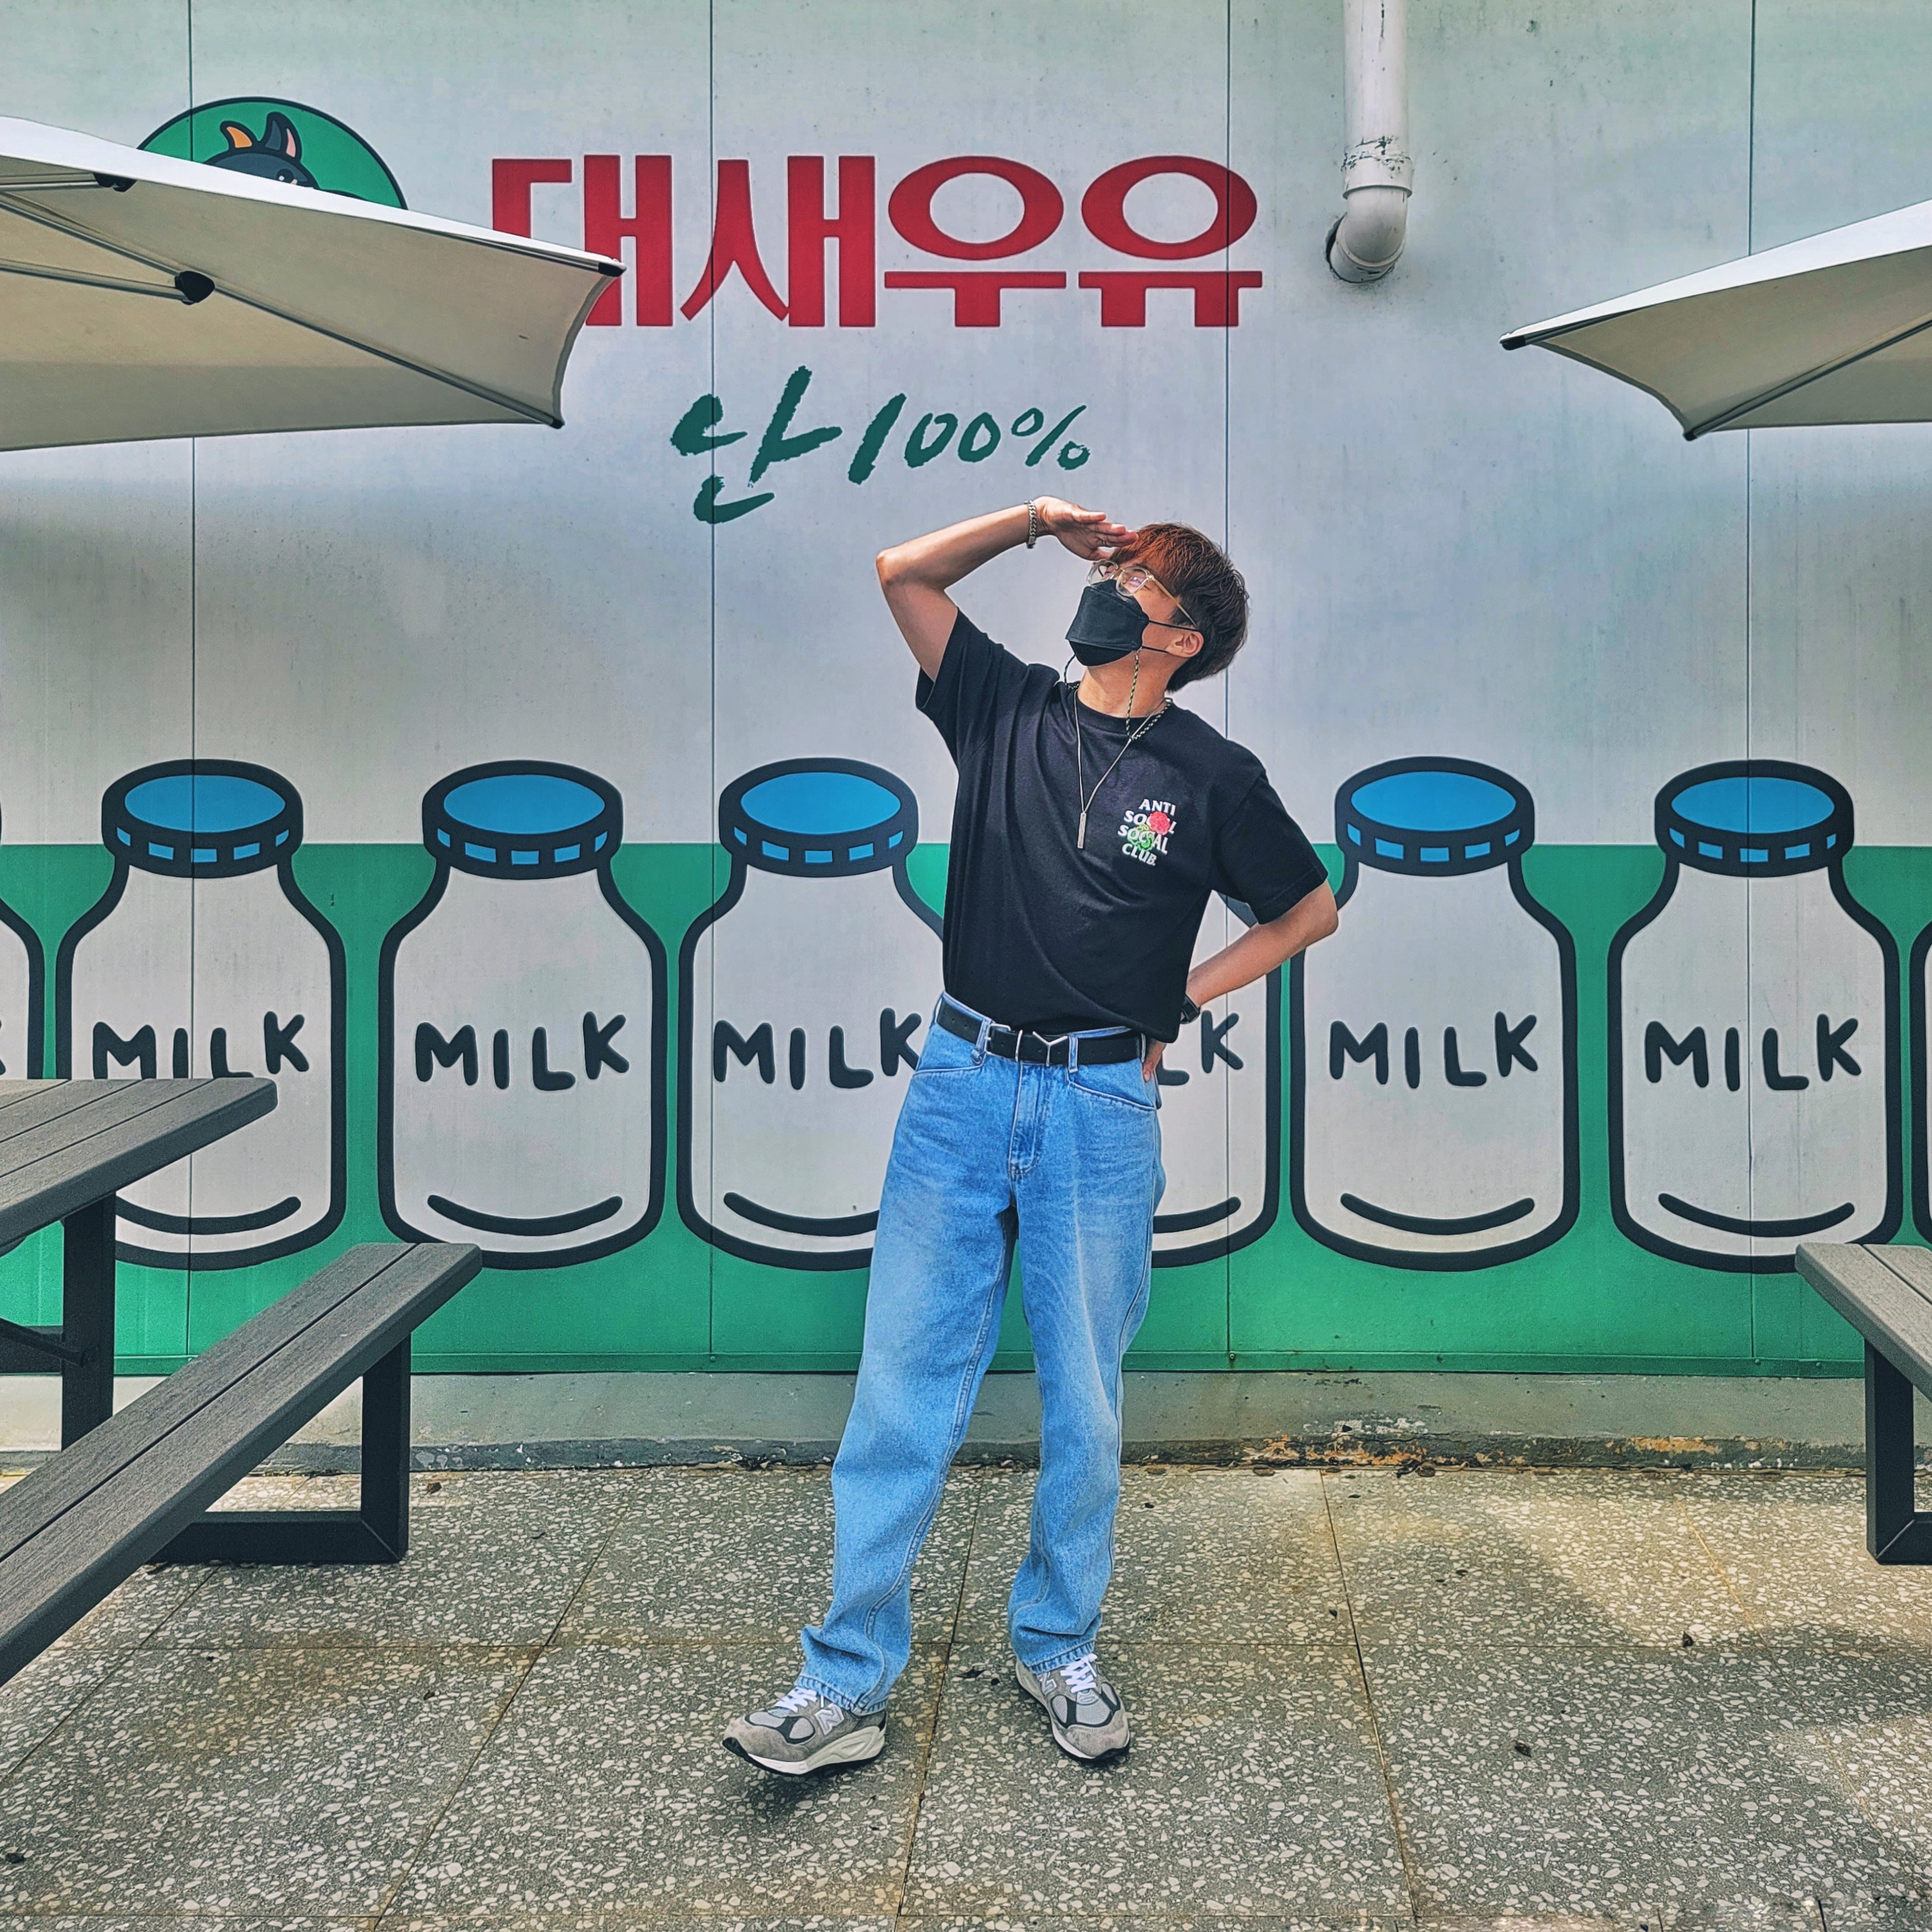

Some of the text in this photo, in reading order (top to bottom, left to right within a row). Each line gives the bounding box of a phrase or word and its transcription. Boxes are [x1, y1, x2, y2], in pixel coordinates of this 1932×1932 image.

[1138, 799, 1176, 816] ANTI
[1122, 843, 1157, 865] CLUB
[92, 1011, 310, 1079] MILK
[415, 1011, 629, 1092] MILK
[714, 1007, 922, 1090] MILK
[1329, 1011, 1538, 1089] MILK
[1644, 1014, 1862, 1092] MILK
